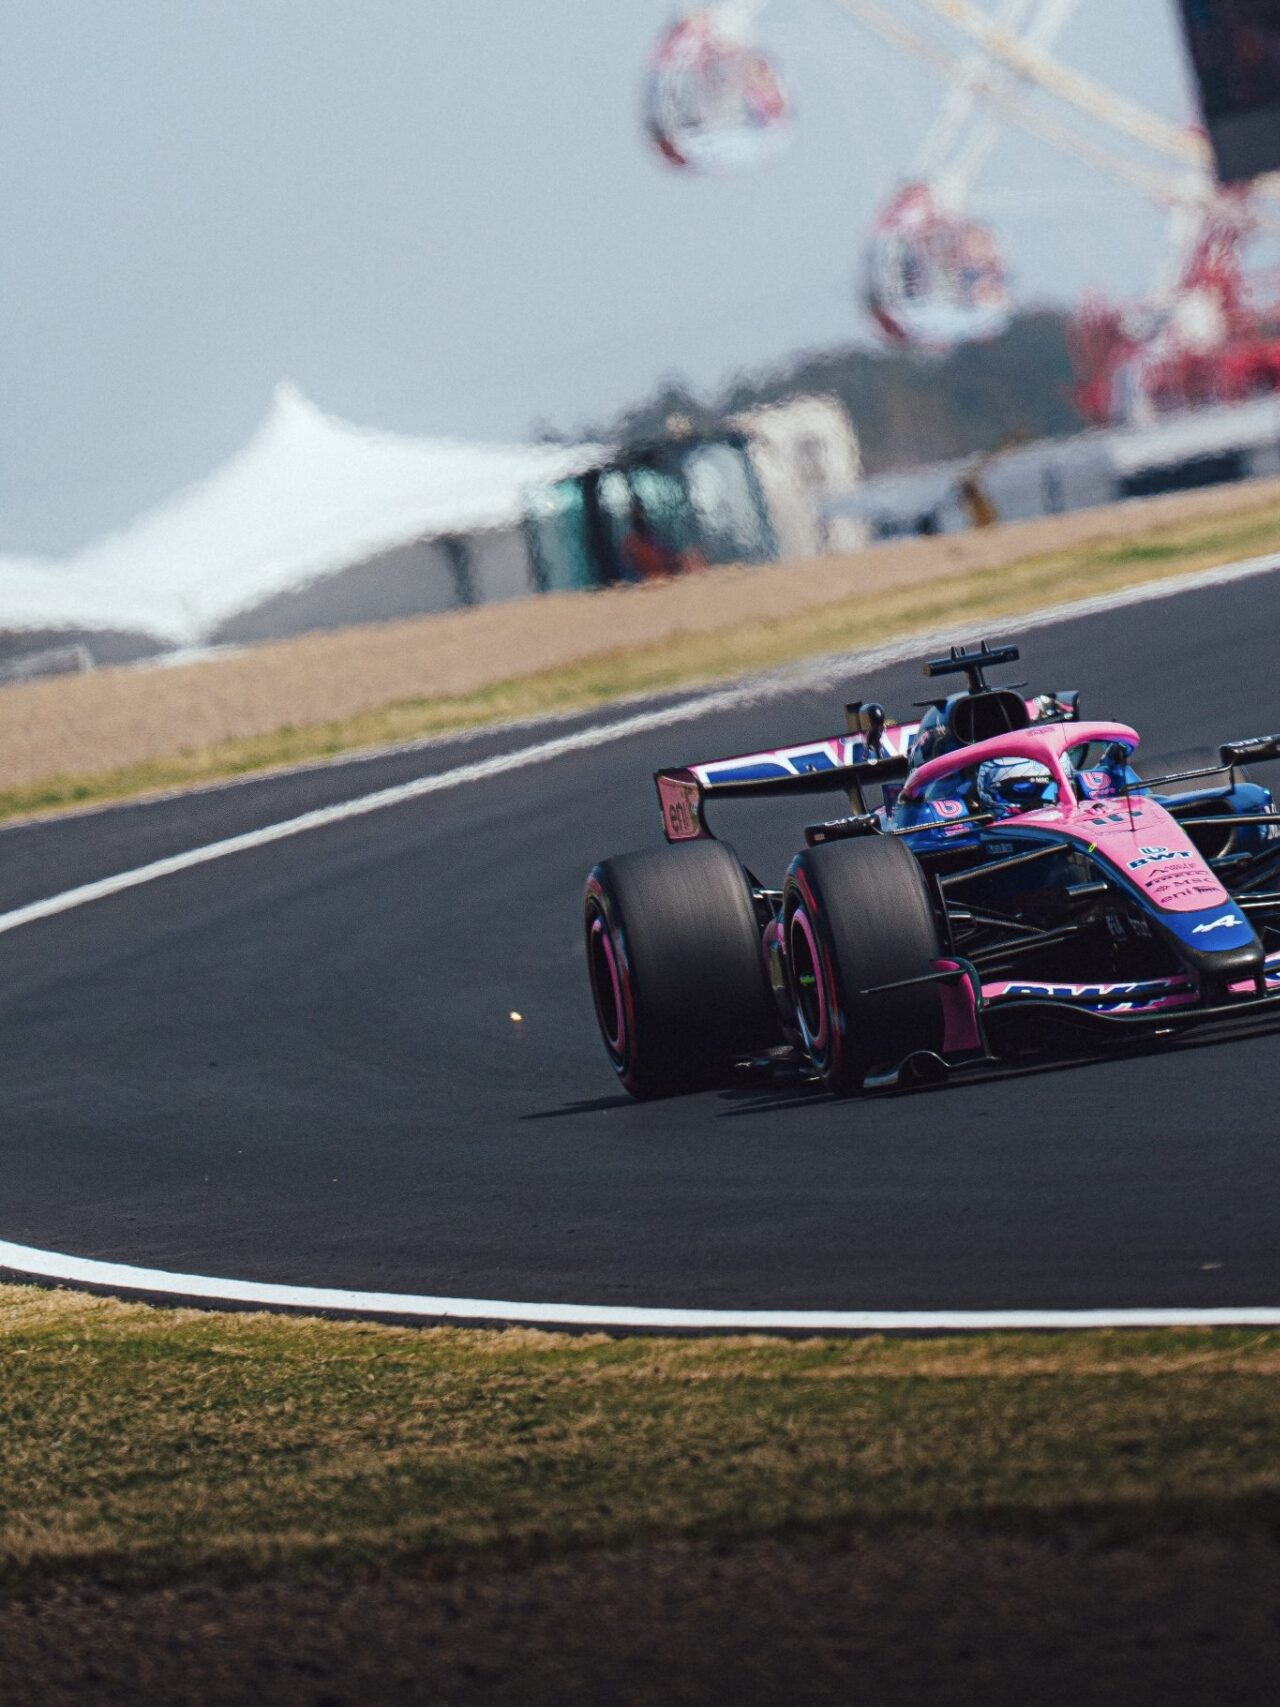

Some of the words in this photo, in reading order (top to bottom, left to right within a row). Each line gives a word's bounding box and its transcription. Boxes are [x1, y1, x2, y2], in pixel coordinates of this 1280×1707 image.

[1127, 851, 1192, 871] BWT
[1173, 878, 1217, 887] MSC
[1160, 888, 1192, 903] eni
